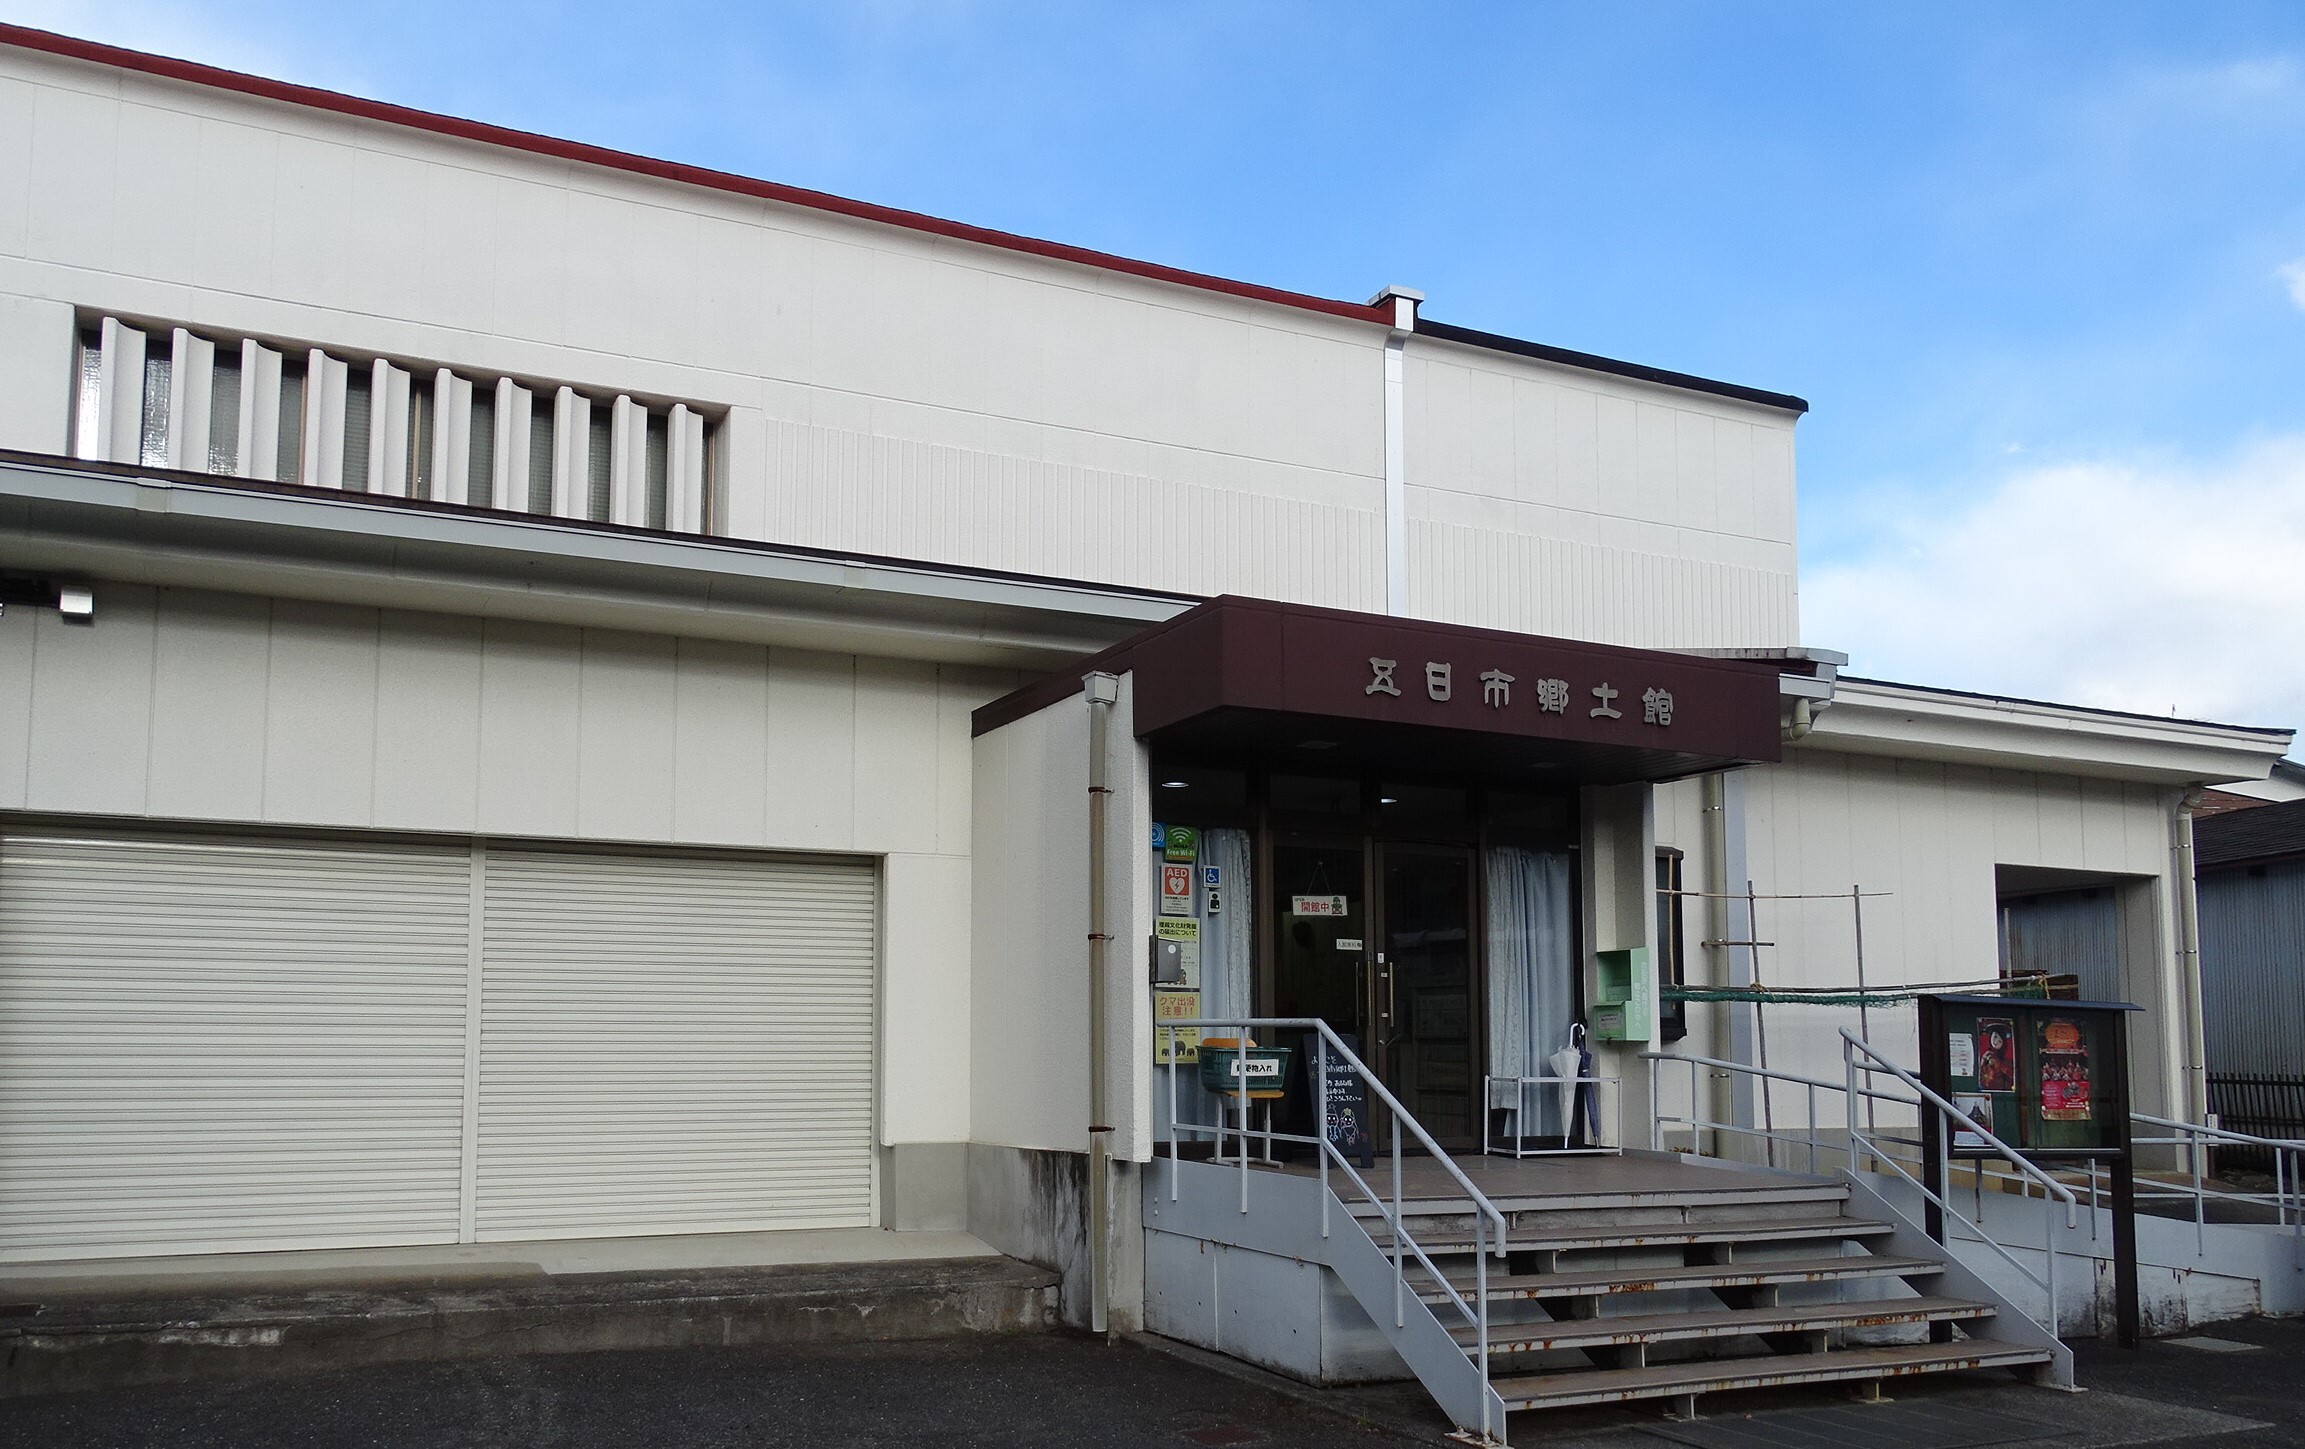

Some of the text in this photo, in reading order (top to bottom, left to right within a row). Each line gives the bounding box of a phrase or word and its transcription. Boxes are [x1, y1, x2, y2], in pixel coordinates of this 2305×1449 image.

[1365, 657, 1674, 727] 五日市郷土館
[1167, 868, 1188, 877] AED
[1301, 901, 1329, 913] 開館中
[1158, 929, 1197, 937] の届出について
[1159, 996, 1196, 1007] クマ出没
[1311, 1055, 1337, 1065] よこそ
